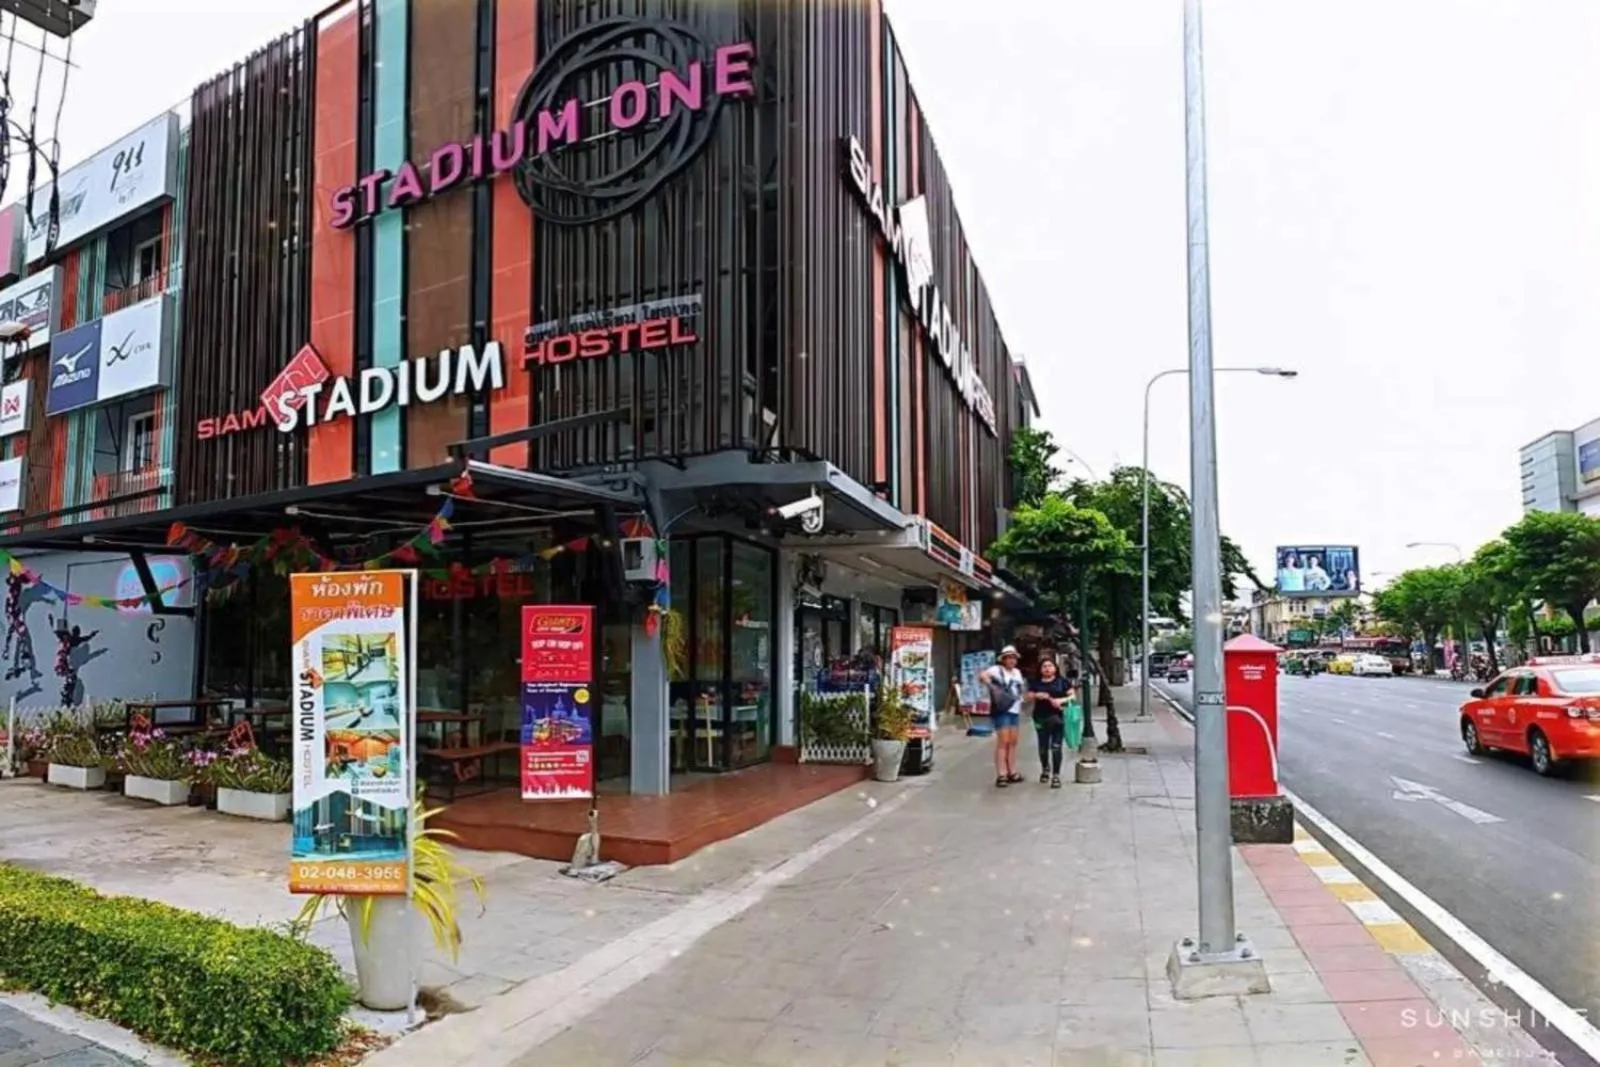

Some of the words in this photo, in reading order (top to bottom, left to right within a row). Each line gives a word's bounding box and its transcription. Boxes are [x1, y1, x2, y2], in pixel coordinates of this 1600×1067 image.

[329, 98, 580, 229] STADIUM
[610, 41, 756, 130] ONE
[849, 133, 903, 265] SIAM
[197, 406, 266, 440] SIAM
[277, 341, 504, 433] STADIUM
[519, 316, 697, 371] HOSTEL
[311, 575, 384, 597] ห้องพัก
[299, 671, 316, 742] STADIUM
